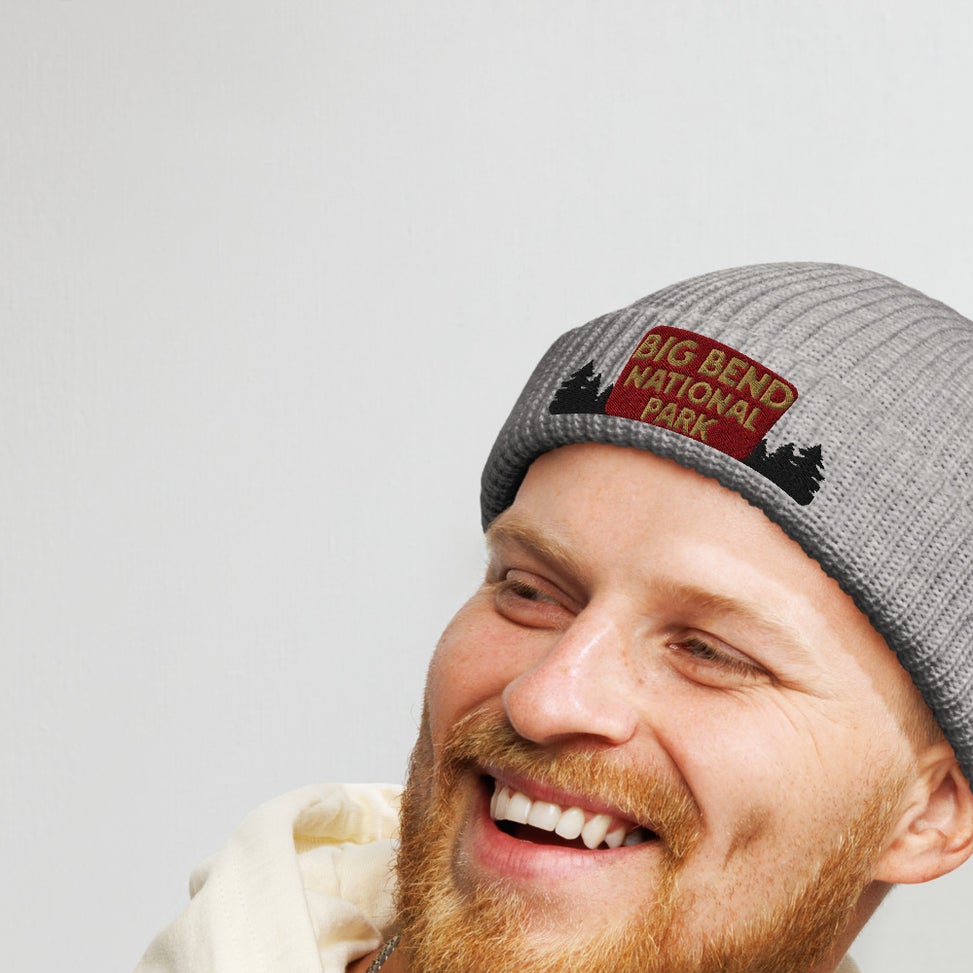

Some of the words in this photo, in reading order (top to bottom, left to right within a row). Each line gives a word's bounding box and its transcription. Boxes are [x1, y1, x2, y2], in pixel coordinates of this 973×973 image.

[624, 365, 763, 432] NATIONAL
[632, 334, 699, 367] BIG
[698, 348, 795, 410] BEND
[641, 397, 719, 441] PARK
